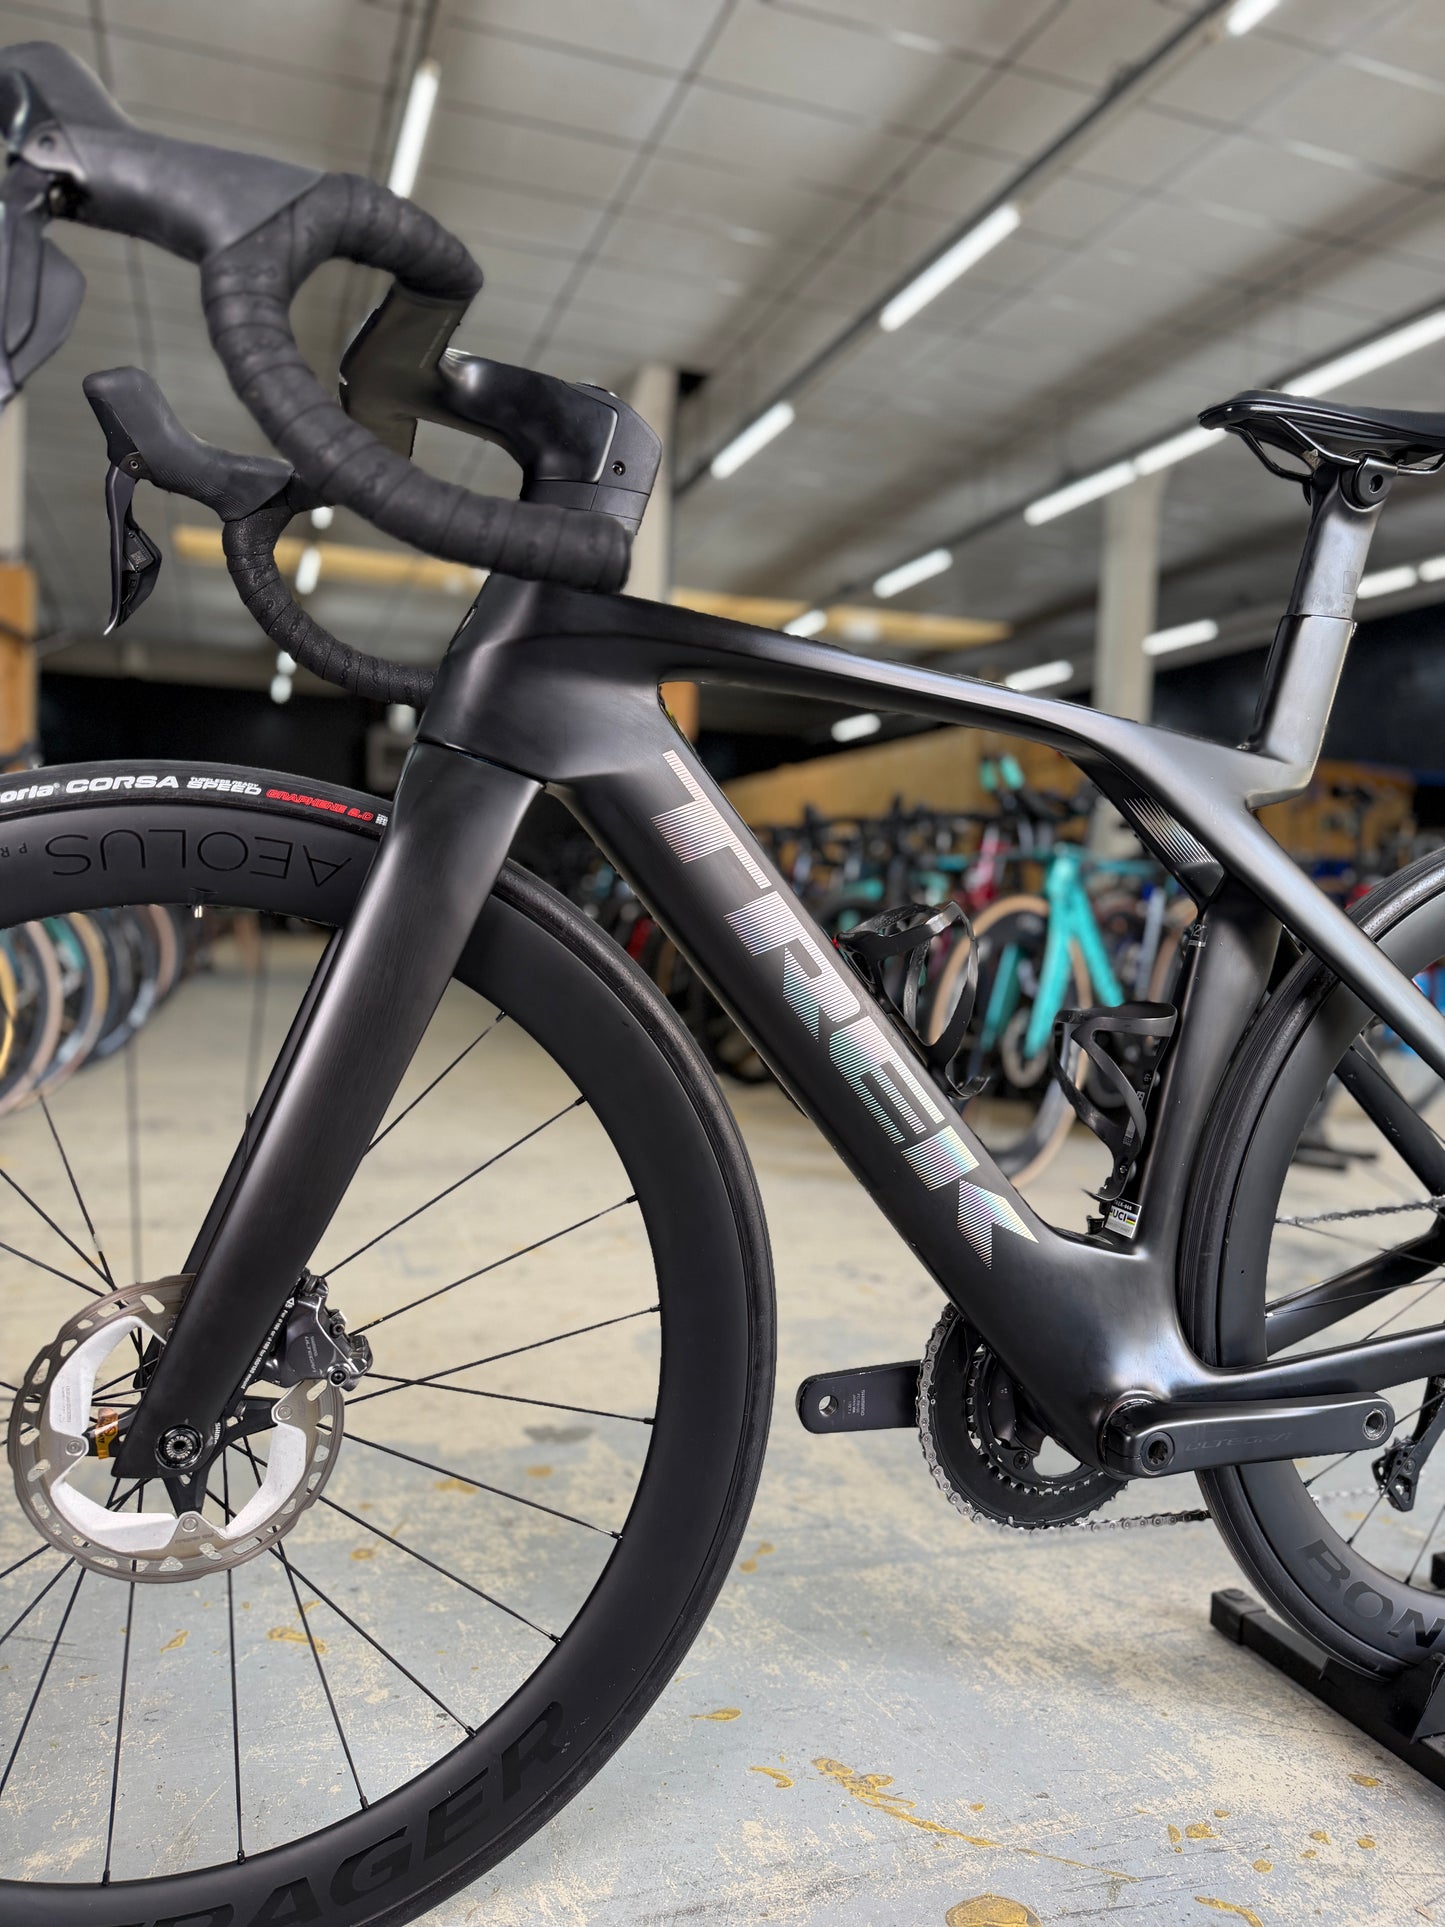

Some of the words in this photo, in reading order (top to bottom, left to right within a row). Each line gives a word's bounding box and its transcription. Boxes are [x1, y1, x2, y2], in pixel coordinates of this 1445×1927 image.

[66, 775, 179, 793] CORSA
[187, 781, 262, 796] SPEED
[266, 789, 348, 814] GRAPHENE
[45, 829, 352, 887] AEOLUS
[651, 750, 1039, 1269] TREK
[1112, 1208, 1127, 1222] UCI
